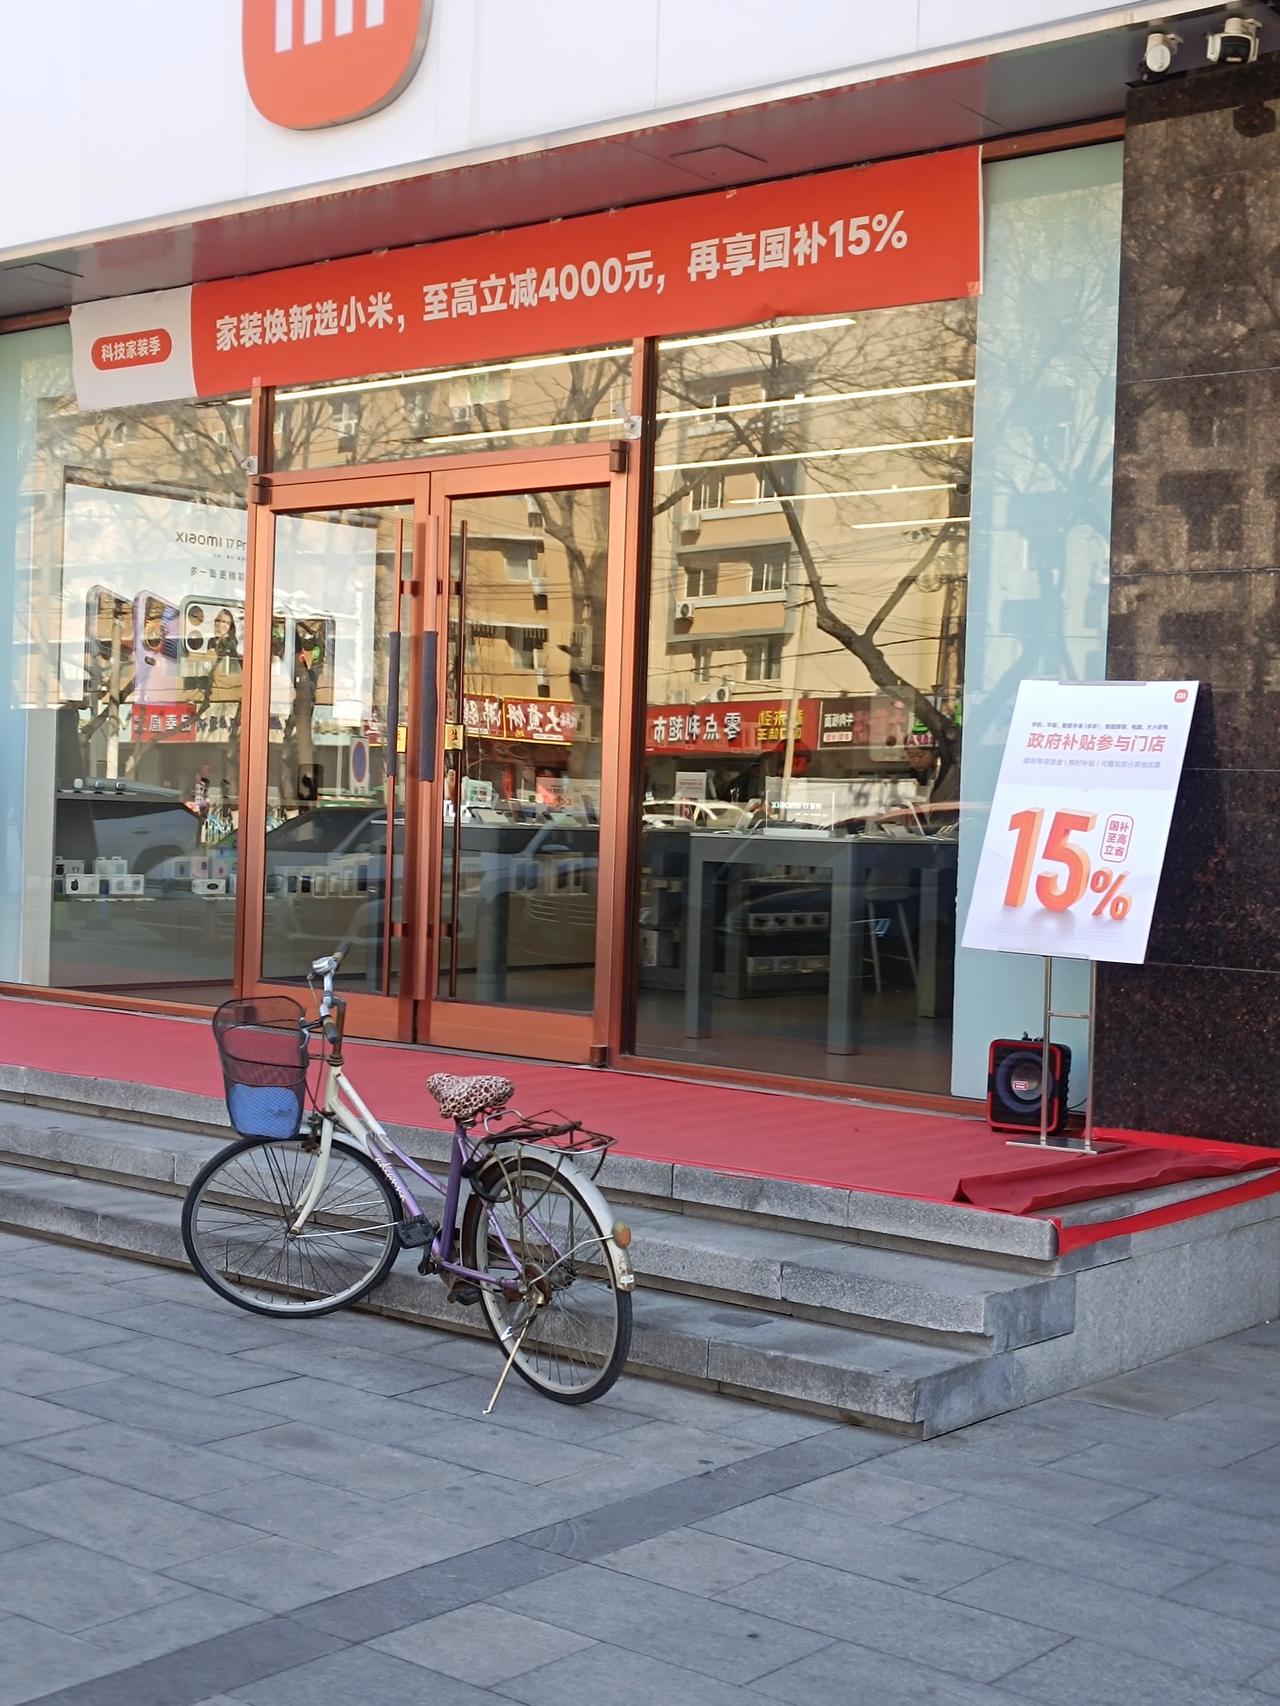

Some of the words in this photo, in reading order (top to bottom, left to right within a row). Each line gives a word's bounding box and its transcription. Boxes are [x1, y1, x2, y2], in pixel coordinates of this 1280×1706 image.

[101, 335, 161, 362] 科技家装季
[226, 538, 234, 548] 17
[1027, 732, 1166, 753] 政府补贴参与门店
[1108, 820, 1130, 832] 国补
[1106, 832, 1127, 844] 至高
[1104, 844, 1125, 857] 立省
[1003, 807, 1132, 921] 15%
